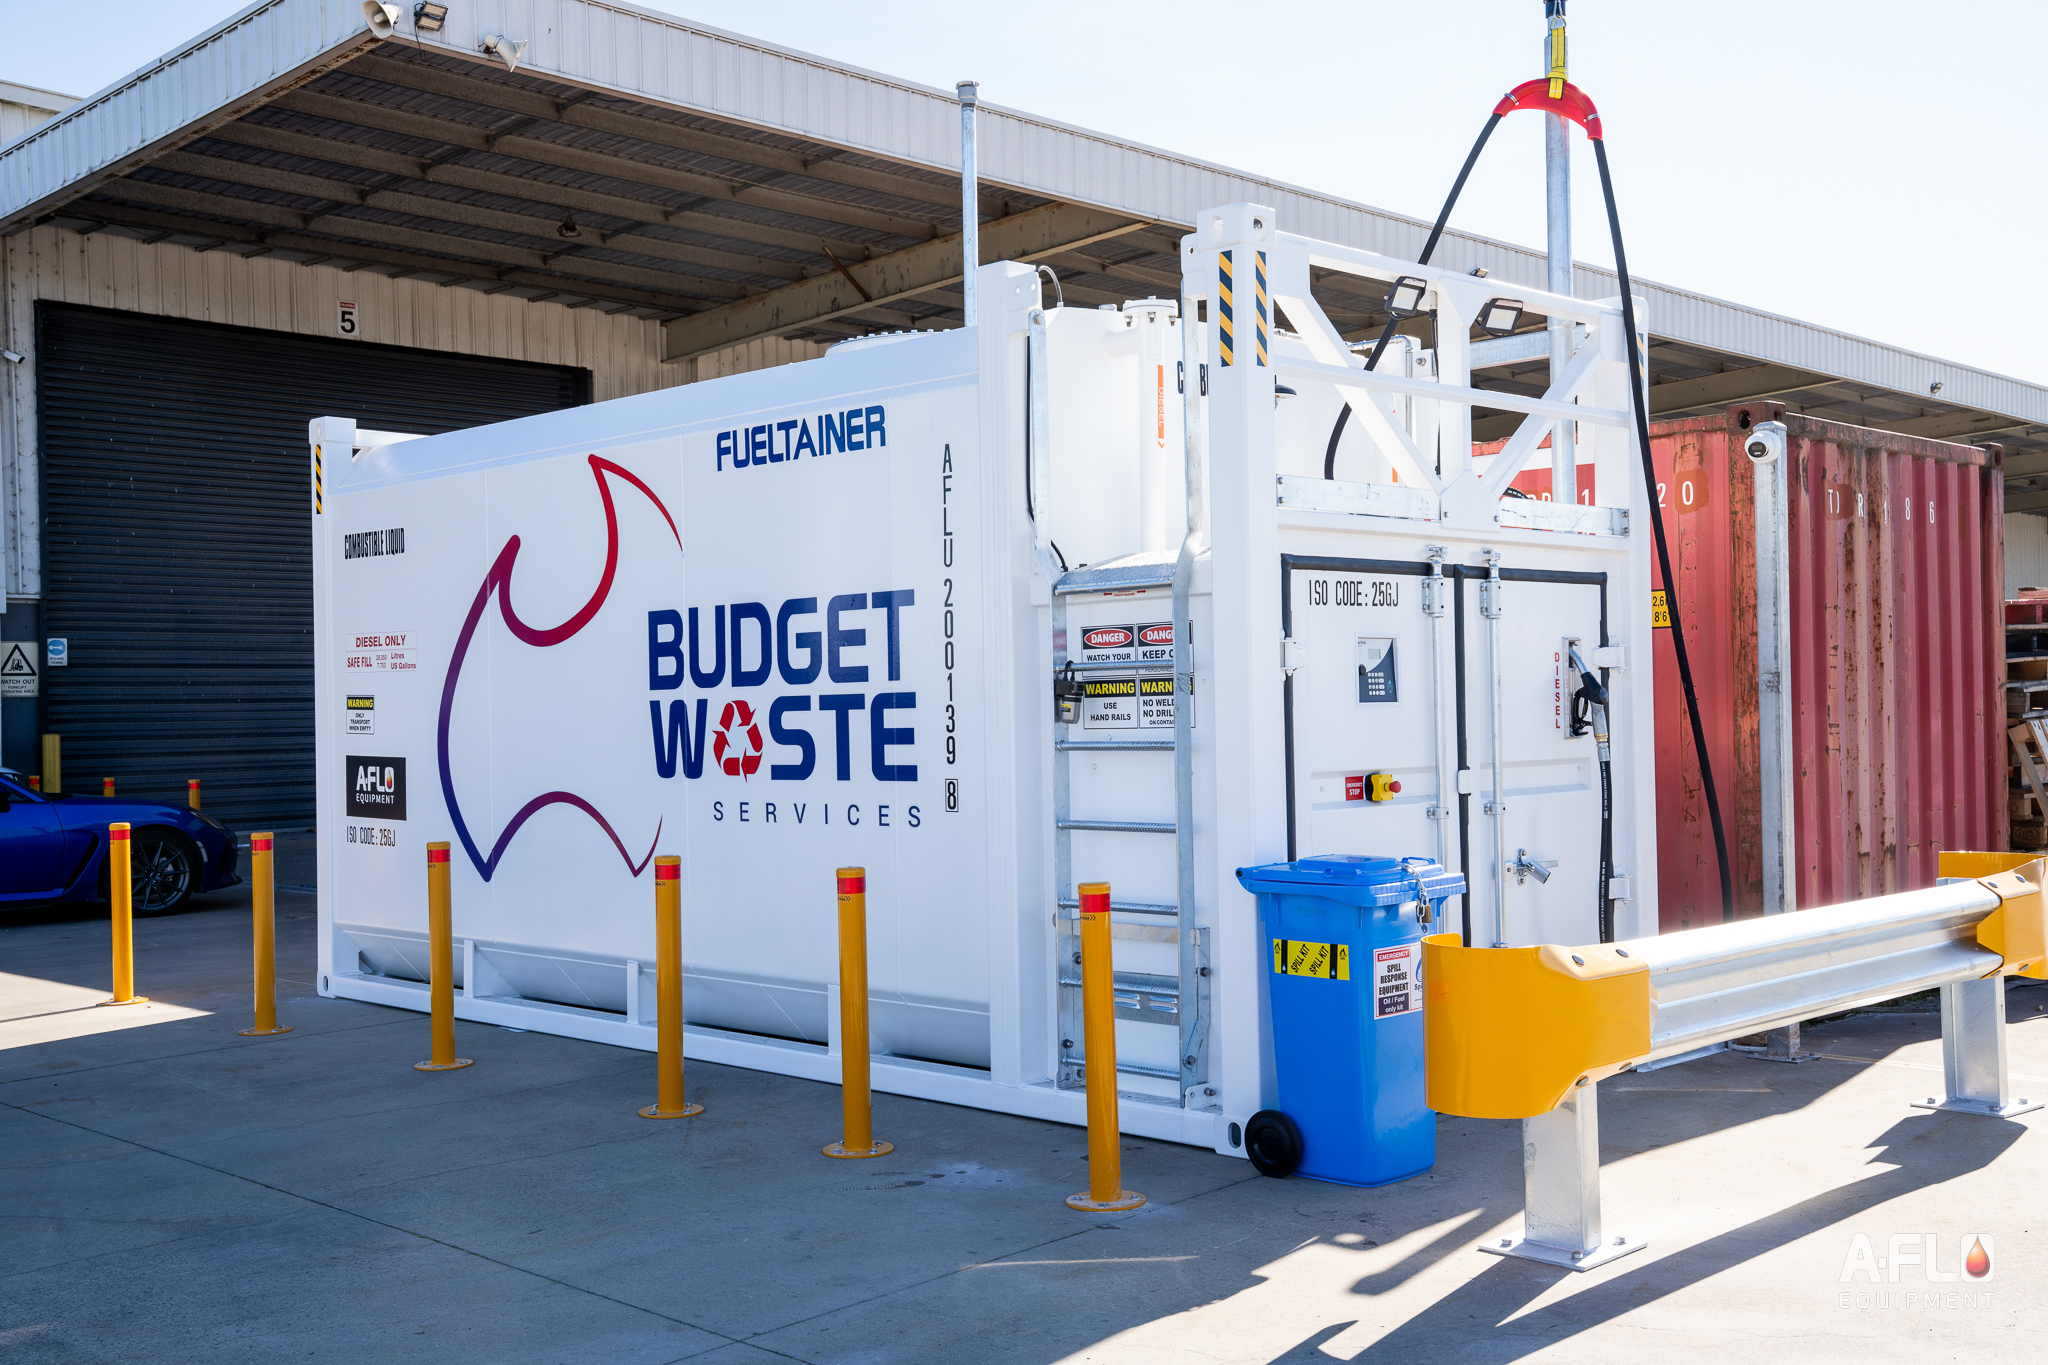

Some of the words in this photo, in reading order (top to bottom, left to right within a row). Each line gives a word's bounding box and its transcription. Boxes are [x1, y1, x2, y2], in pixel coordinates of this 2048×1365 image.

[341, 310, 355, 333] 5
[716, 405, 886, 472] FUELTAINER
[942, 444, 954, 567] AFLU
[344, 530, 384, 560] COMBUSTIBLE
[385, 528, 404, 556] LIQUID
[1309, 579, 1328, 606] ISO
[1372, 582, 1398, 607] 25GJ
[356, 636, 382, 648] DIESEL
[385, 634, 406, 646] ONLY
[648, 589, 914, 690] BUDGET
[1091, 632, 1125, 643] DANGER
[1147, 630, 1174, 640] DANG
[1142, 650, 1166, 659] KEEP
[347, 657, 360, 668] SAFE
[361, 656, 372, 667] FILL
[943, 578, 957, 765] 200139
[1086, 682, 1135, 694] WARNING
[1141, 681, 1173, 693] WARN
[348, 699, 373, 708] WARNING
[356, 793, 394, 804] EQUIPMENT
[946, 780, 957, 811] 8
[713, 801, 921, 828] SERVICES
[347, 826, 356, 843] ISO
[1298, 904, 1320, 914] SULO
[1291, 955, 1304, 973] SPILL
[1299, 944, 1310, 958] KIT
[1309, 957, 1323, 975] SPILL
[1318, 946, 1329, 960] KIT
[1380, 951, 1408, 960] EMERGENCY
[1387, 963, 1401, 973] SPILL
[1381, 972, 1407, 984] RESPONSE
[1379, 982, 1408, 995] EQUIPMENT
